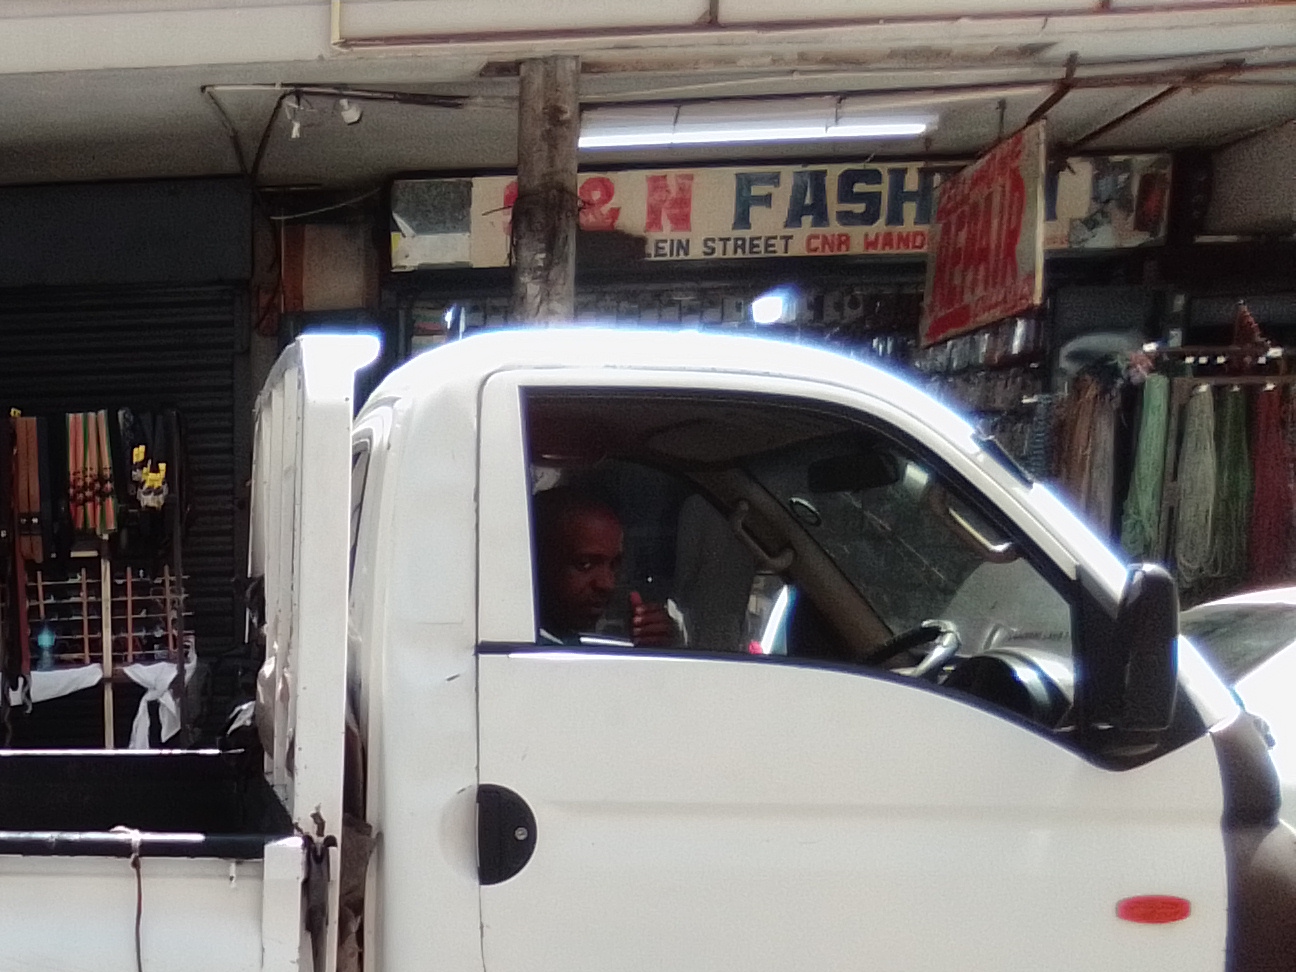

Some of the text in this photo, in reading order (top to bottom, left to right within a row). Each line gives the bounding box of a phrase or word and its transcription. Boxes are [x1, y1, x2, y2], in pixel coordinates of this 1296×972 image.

[644, 173, 695, 232] N
[731, 167, 933, 231] FASH
[646, 230, 929, 258] EIN STREET CNR WAND
